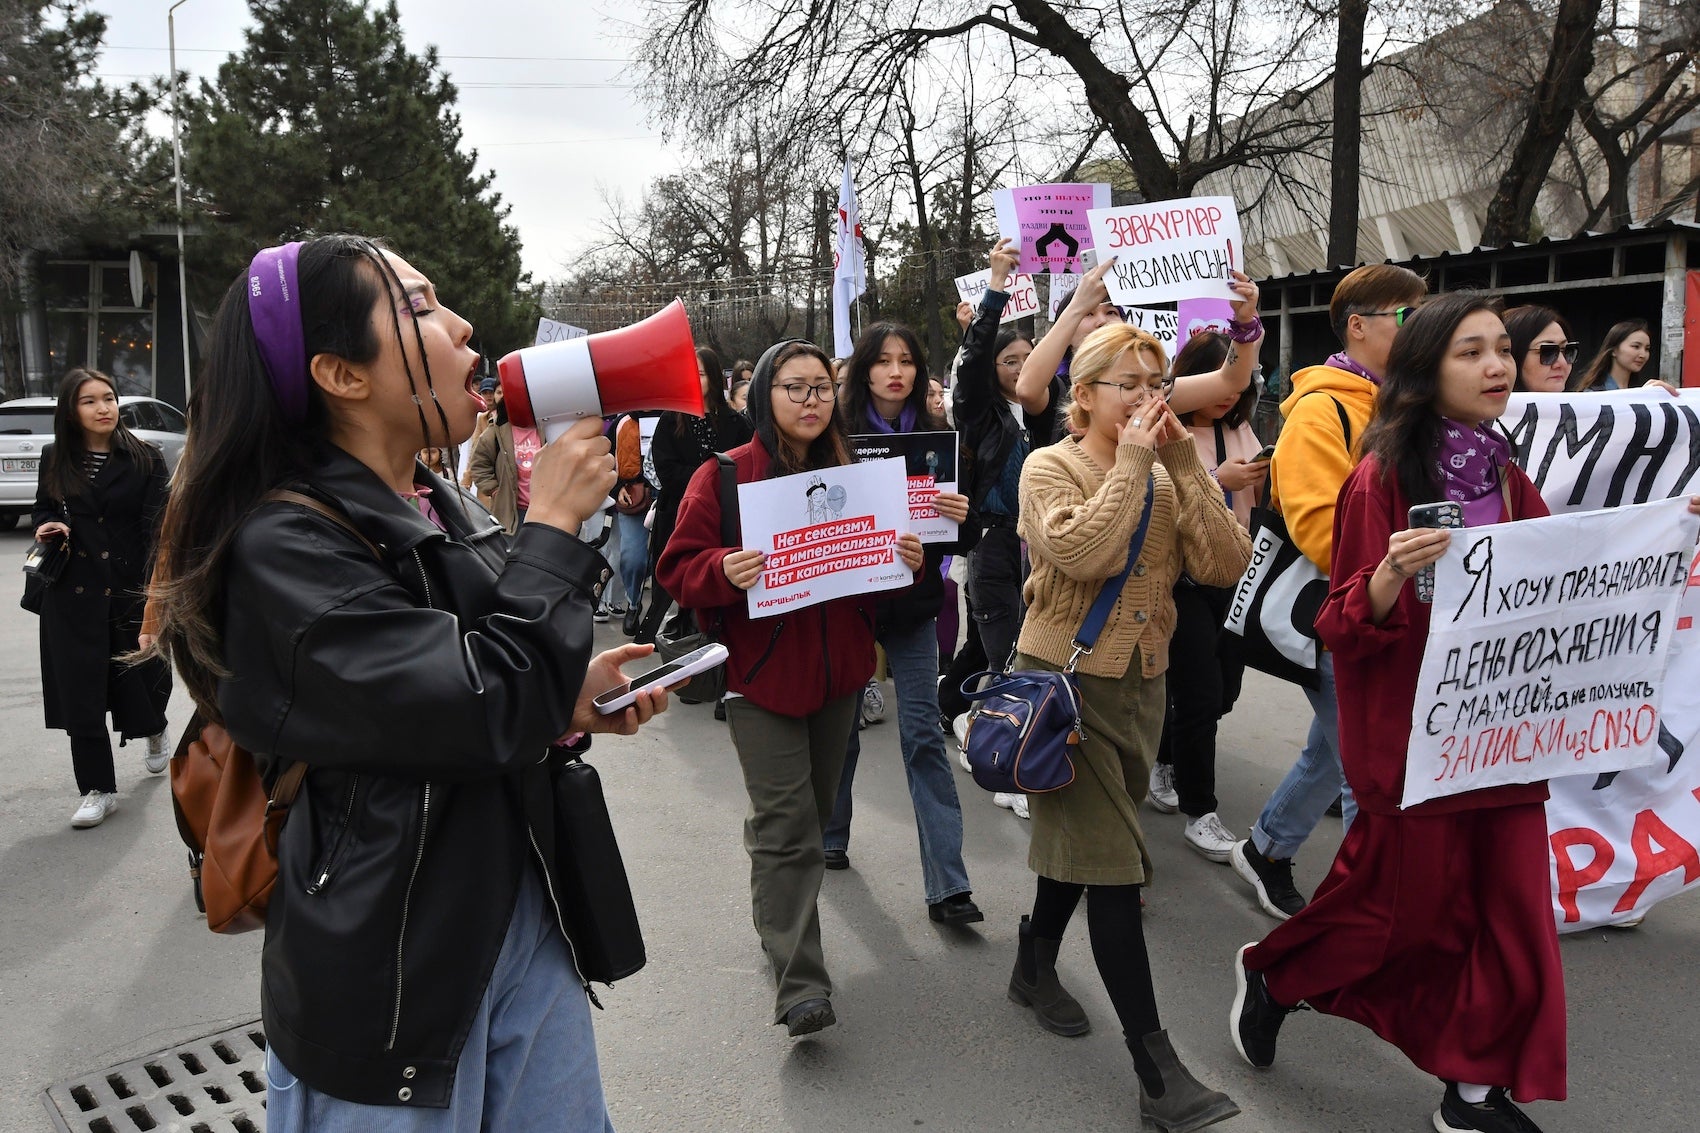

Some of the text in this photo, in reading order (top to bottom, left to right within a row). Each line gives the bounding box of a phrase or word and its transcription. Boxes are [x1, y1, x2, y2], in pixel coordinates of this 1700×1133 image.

[20, 460, 37, 469] 280
[777, 519, 872, 549] Нет сексизму,
[789, 533, 896, 564] империализму,
[768, 548, 892, 587] Нет капитализму!
[1229, 537, 1273, 625] lamoda
[1452, 535, 1492, 623] Я
[1558, 551, 1688, 604] ПРАЗДНОВАТЬ
[757, 590, 811, 608] КАРШЫЛЫК
[1436, 636, 1506, 695] ДЕНЬ
[1434, 716, 1566, 781] ЗАПИСКИ
